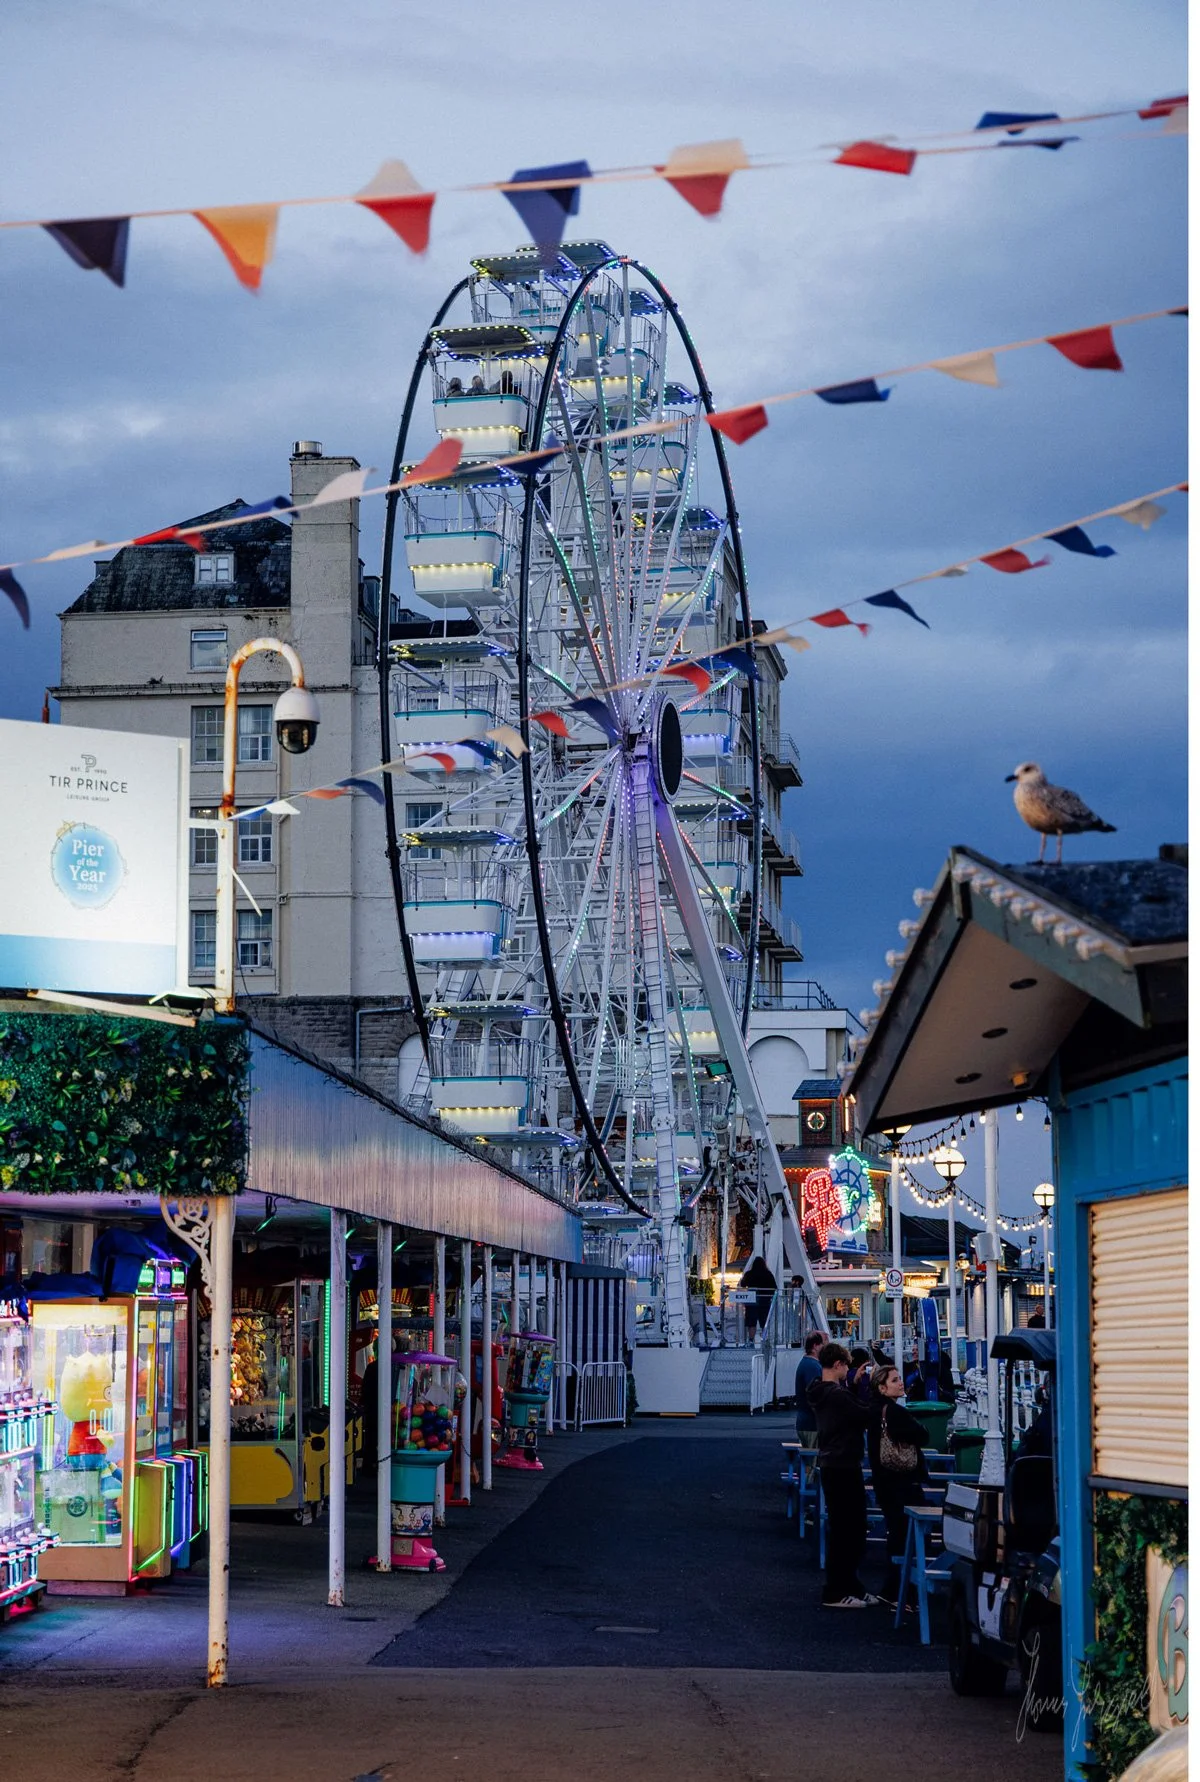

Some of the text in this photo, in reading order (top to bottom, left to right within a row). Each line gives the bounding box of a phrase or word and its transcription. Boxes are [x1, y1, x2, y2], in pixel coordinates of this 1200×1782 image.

[49, 775, 128, 793] TIR PRINCE
[72, 839, 105, 857] Pier
[77, 858, 99, 868] of the
[68, 865, 107, 883] Year
